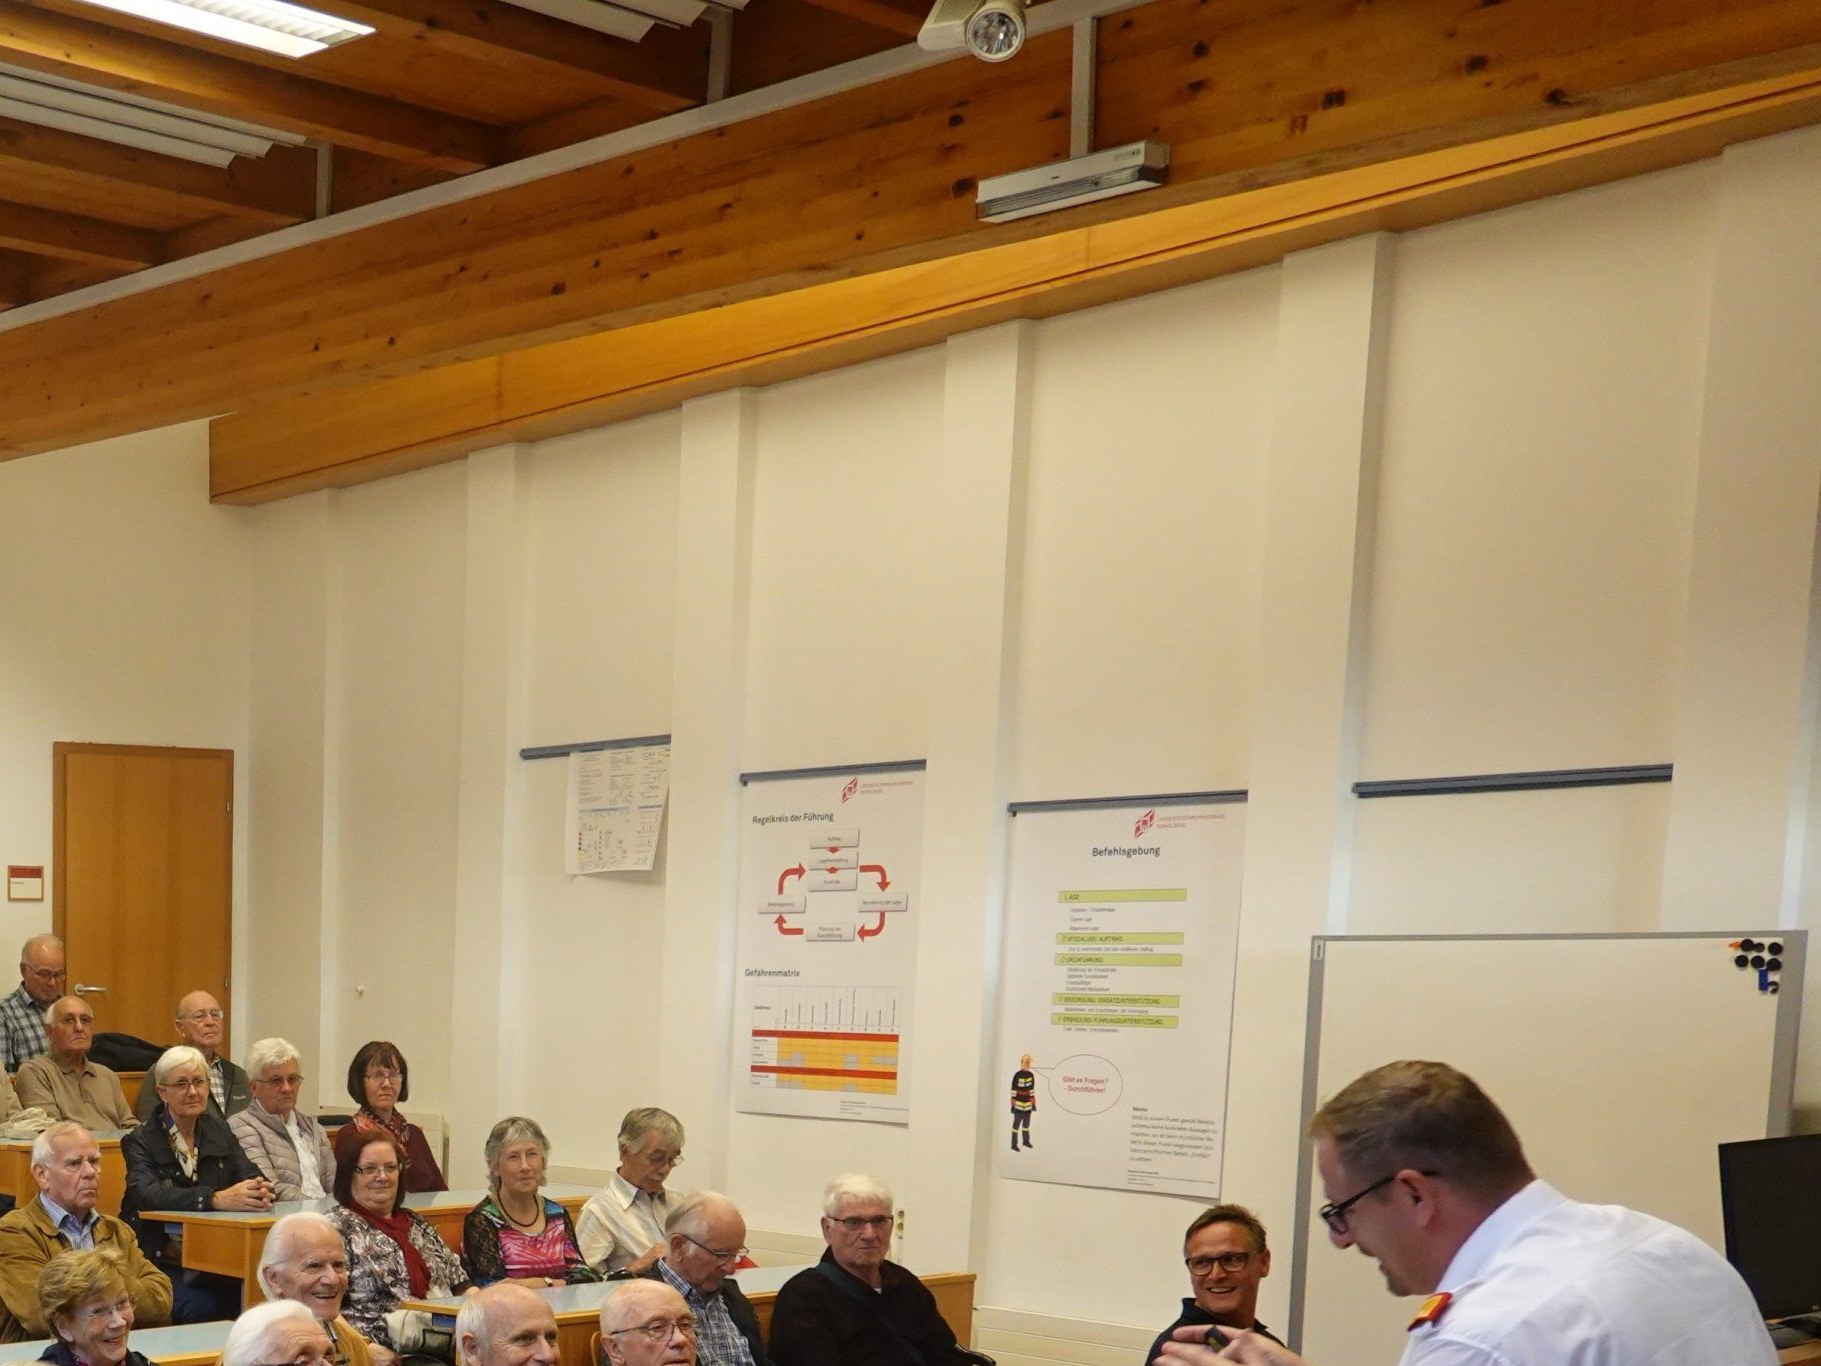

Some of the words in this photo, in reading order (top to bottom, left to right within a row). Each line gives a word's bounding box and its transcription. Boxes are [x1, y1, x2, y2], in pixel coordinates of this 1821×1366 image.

[752, 815, 789, 826] Regelkreis
[790, 814, 802, 822] der
[803, 812, 834, 822] Führung
[1092, 846, 1161, 858] Befehlsgebung
[744, 968, 800, 978] Gefahrenmatrix
